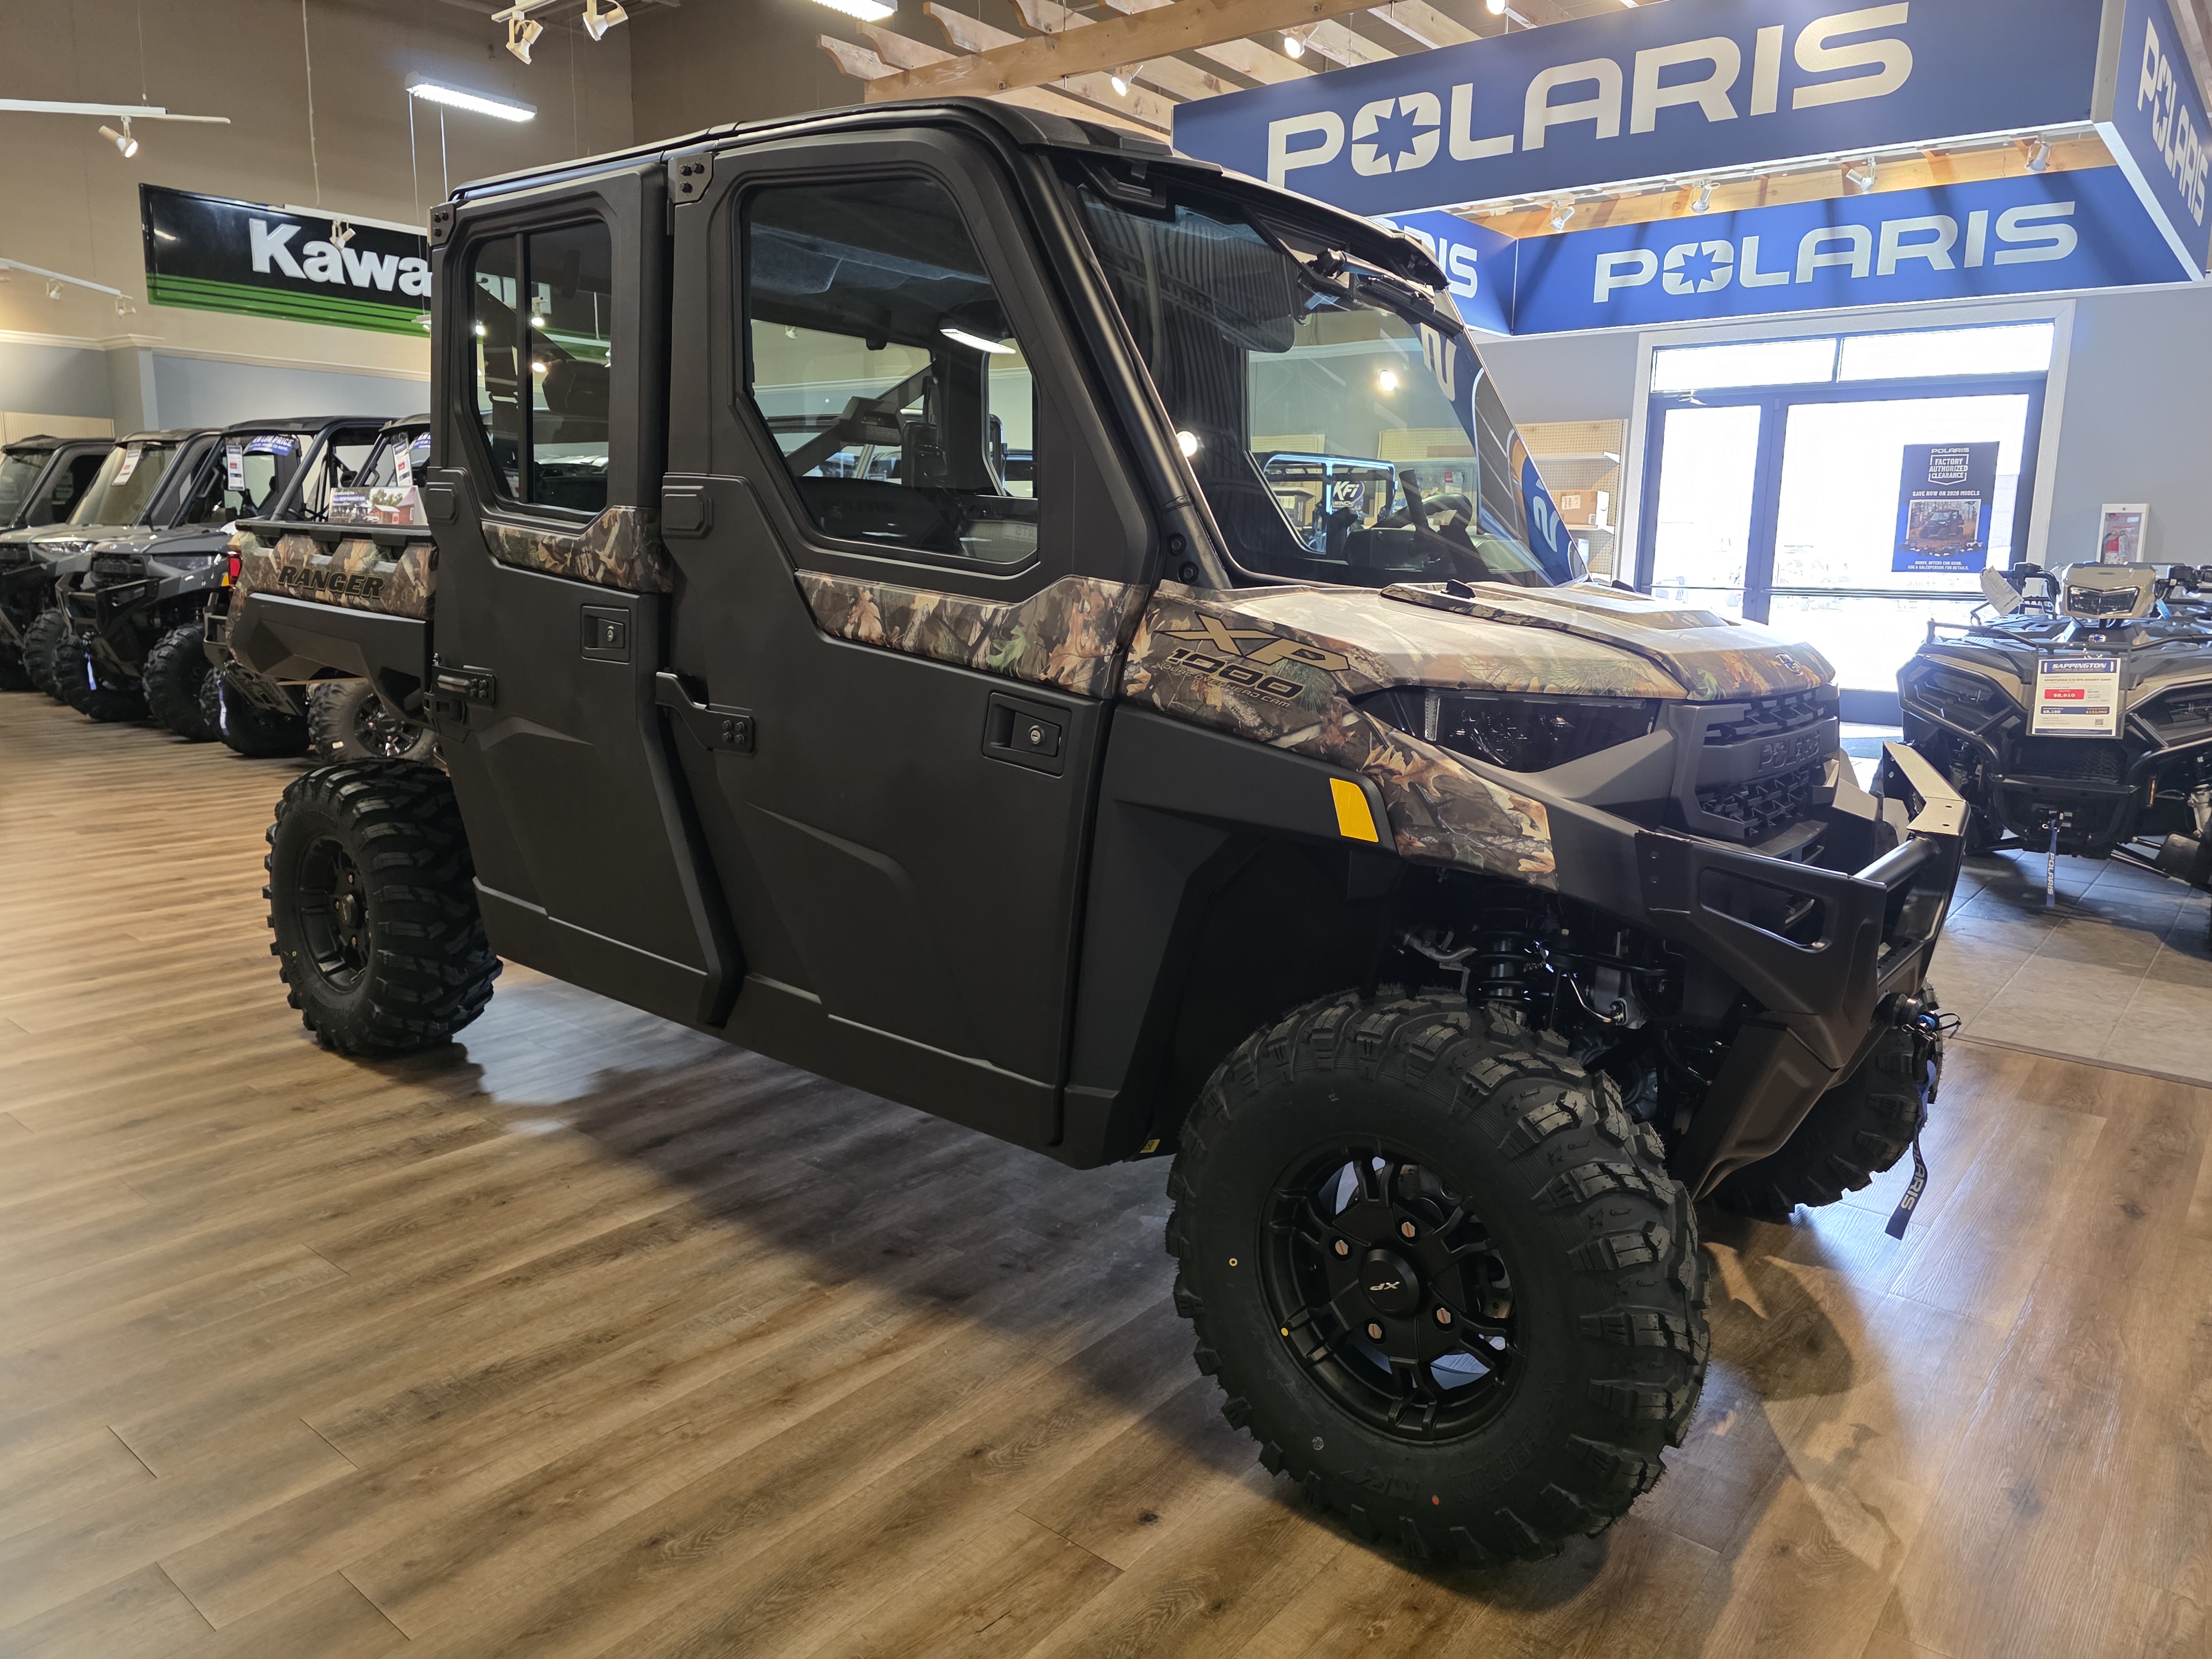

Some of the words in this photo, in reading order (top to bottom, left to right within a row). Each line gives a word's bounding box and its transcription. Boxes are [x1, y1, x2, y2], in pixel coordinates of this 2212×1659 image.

[1267, 2, 1913, 189] POLARIS
[2137, 17, 2208, 227] POLARIS
[1594, 201, 2078, 303] POLARIS
[272, 436, 294, 447] PRICE
[1333, 481, 1360, 500] KFi
[278, 565, 385, 599] RANGER
[1154, 611, 1350, 671] XP
[1162, 664, 1192, 677] DUAL
[1194, 674, 1260, 698] OVERHEAD
[1260, 696, 1291, 708] CAM
[1165, 646, 1306, 701] 1000
[1757, 729, 1820, 772] POLARIS
[1369, 1281, 1401, 1291] XP
